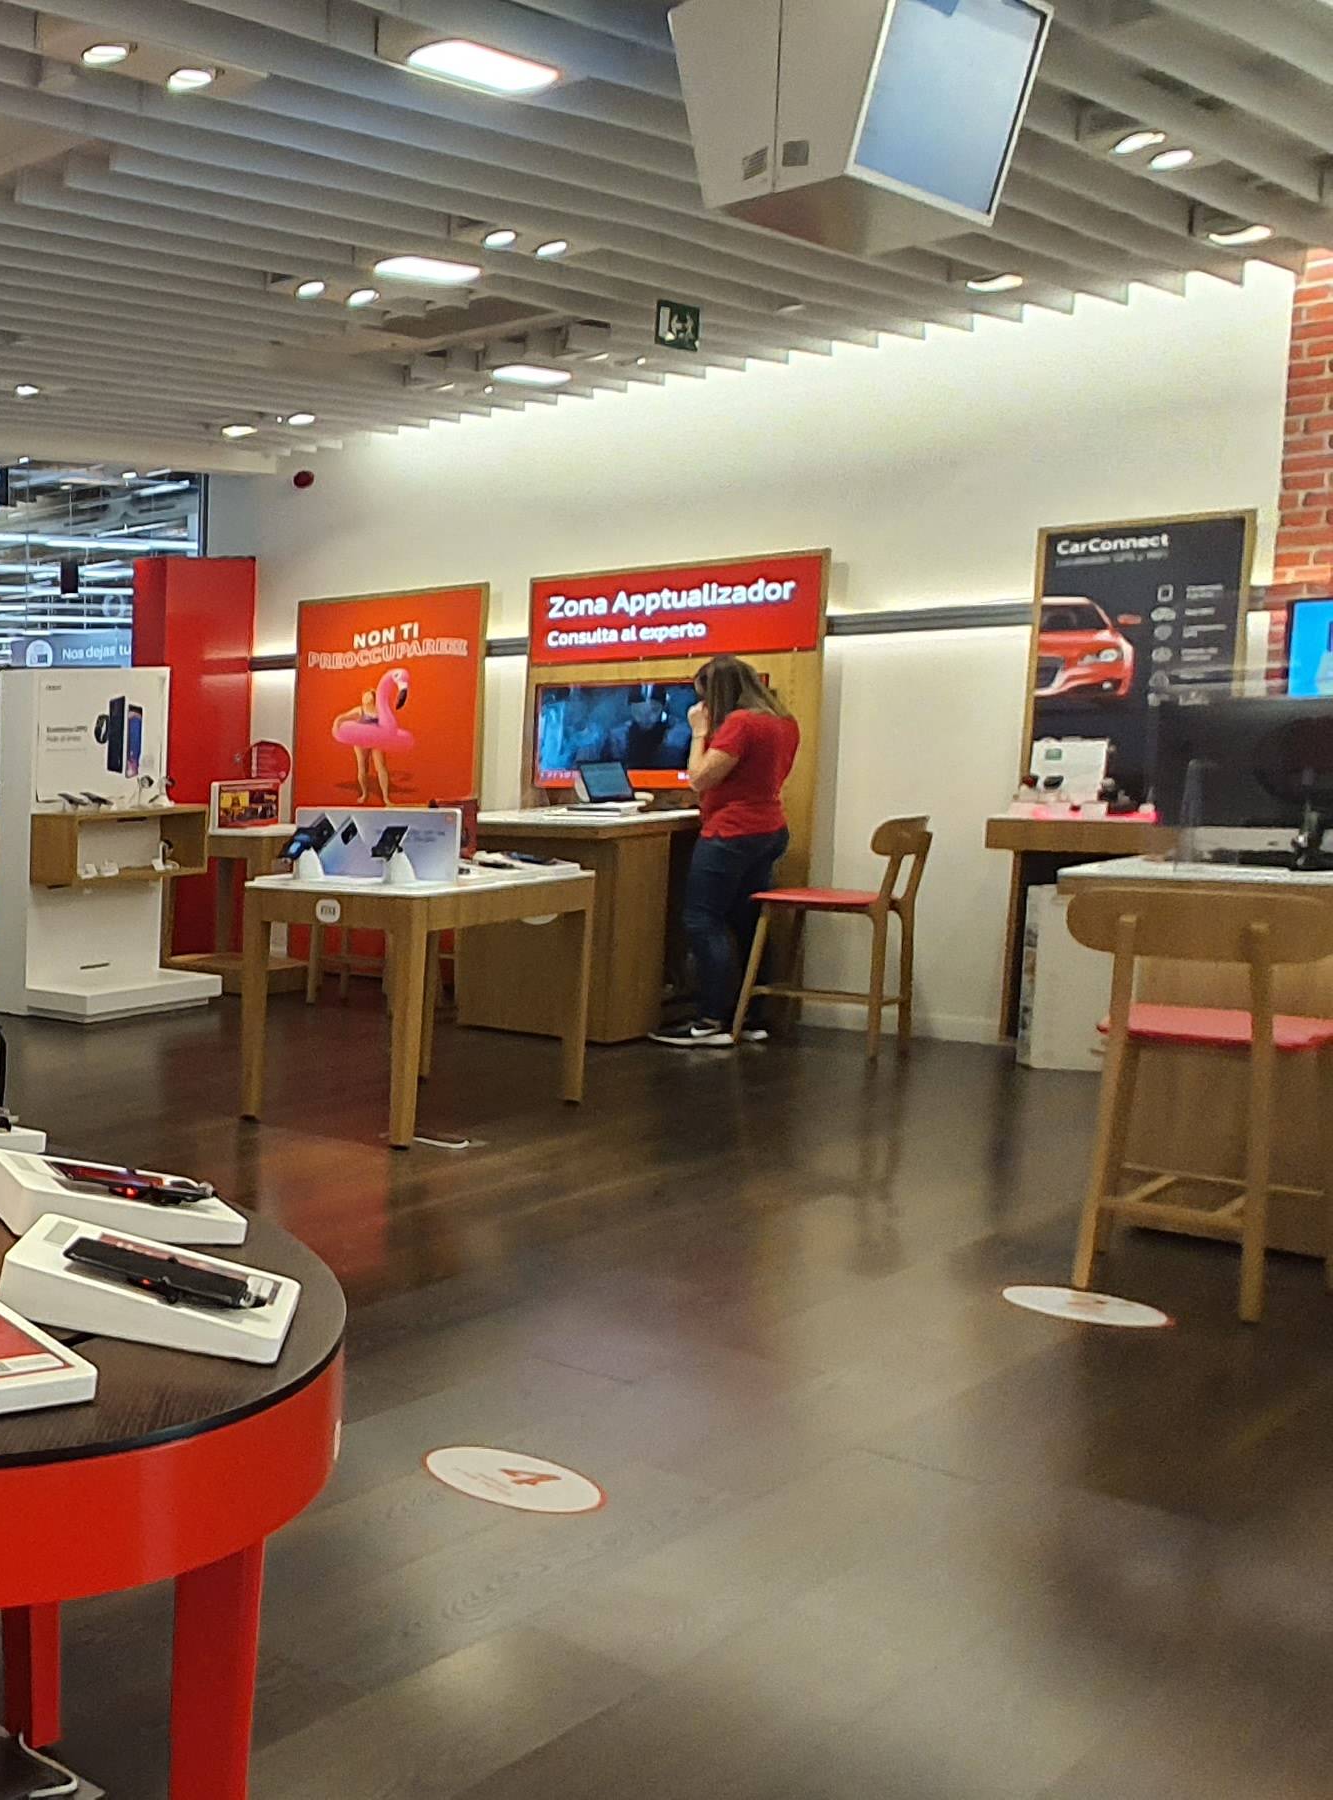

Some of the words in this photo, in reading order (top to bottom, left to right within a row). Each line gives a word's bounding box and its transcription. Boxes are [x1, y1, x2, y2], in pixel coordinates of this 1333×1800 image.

[1056, 532, 1169, 555] CarConnect
[548, 595, 608, 619] Zona
[612, 578, 796, 617] Apptualizador
[353, 626, 395, 650] NON
[400, 621, 419, 640] TI
[547, 625, 618, 648] Consulta
[621, 625, 636, 642] al
[639, 622, 707, 643] experto
[62, 647, 84, 661] Nos
[85, 645, 116, 661] dejas
